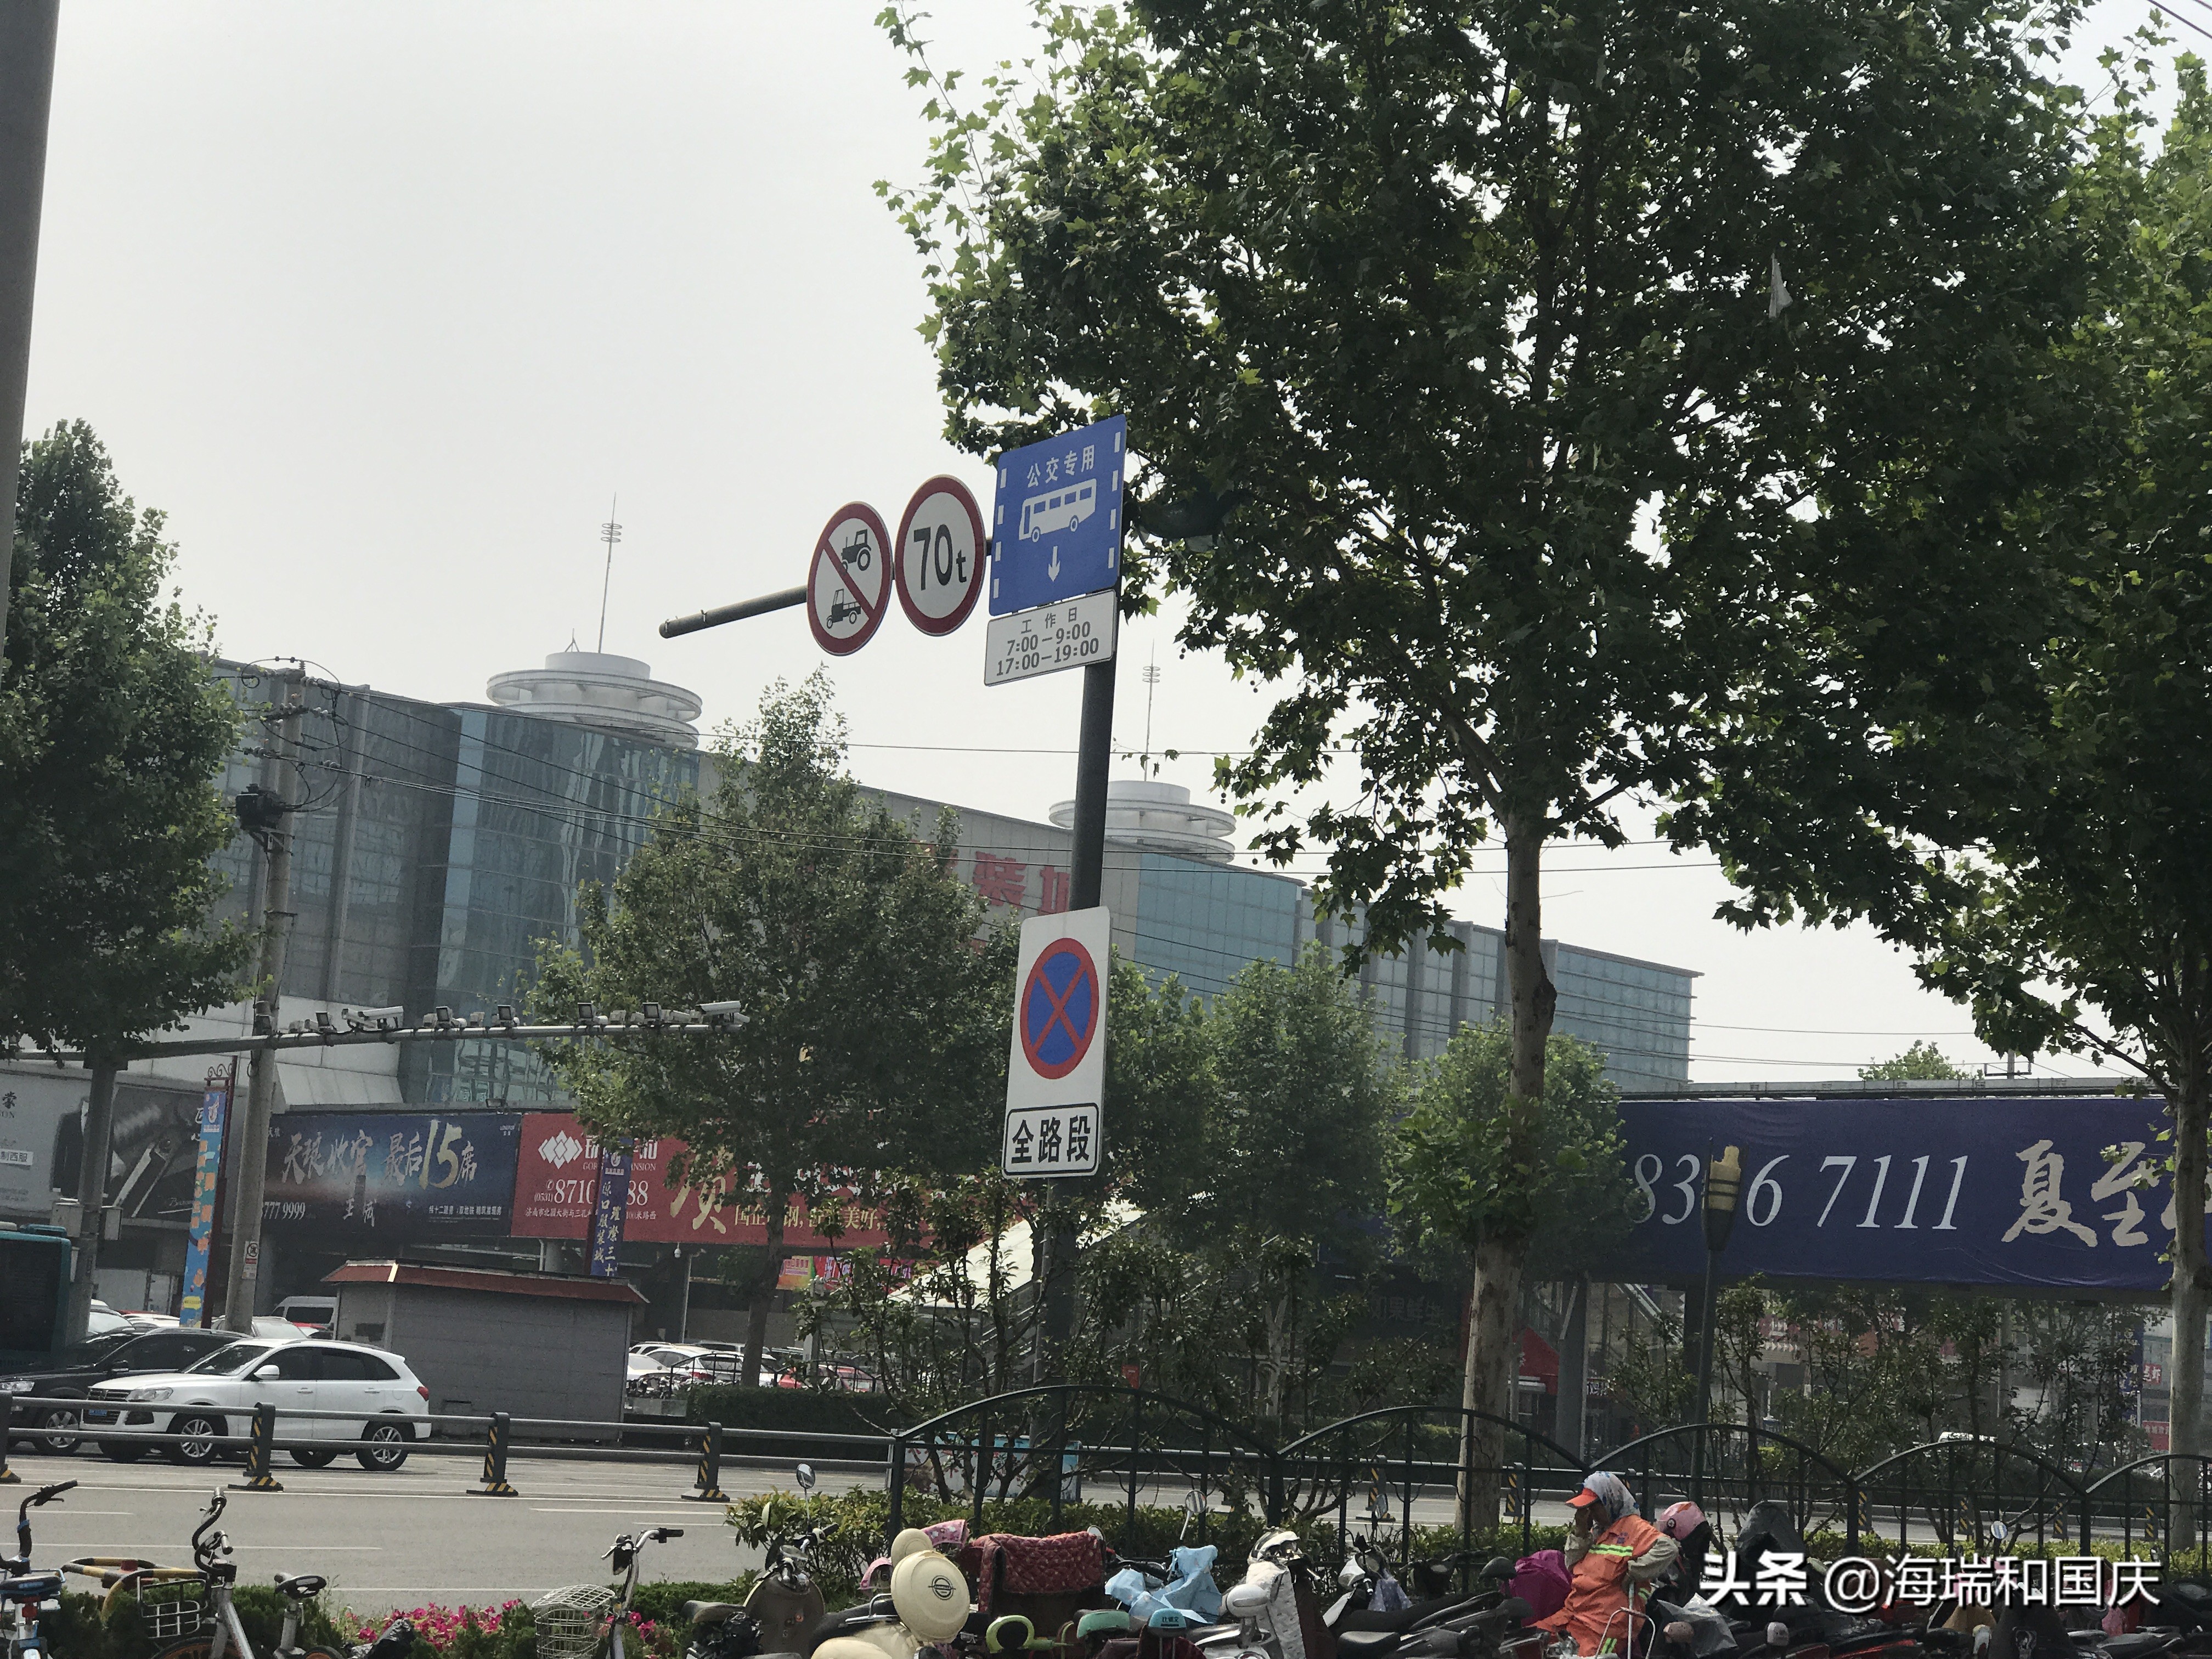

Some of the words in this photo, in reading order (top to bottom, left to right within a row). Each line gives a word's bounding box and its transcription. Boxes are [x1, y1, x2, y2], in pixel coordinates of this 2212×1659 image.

[1027, 444, 1095, 488] 公交专用
[913, 523, 967, 591] 70t
[1020, 607, 1078, 634] 工作日
[1012, 1115, 1091, 1164] 全路段
[625, 1180, 649, 1206] 88
[1817, 1155, 1968, 1231] 7111
[2001, 1139, 2176, 1247] 夏至
